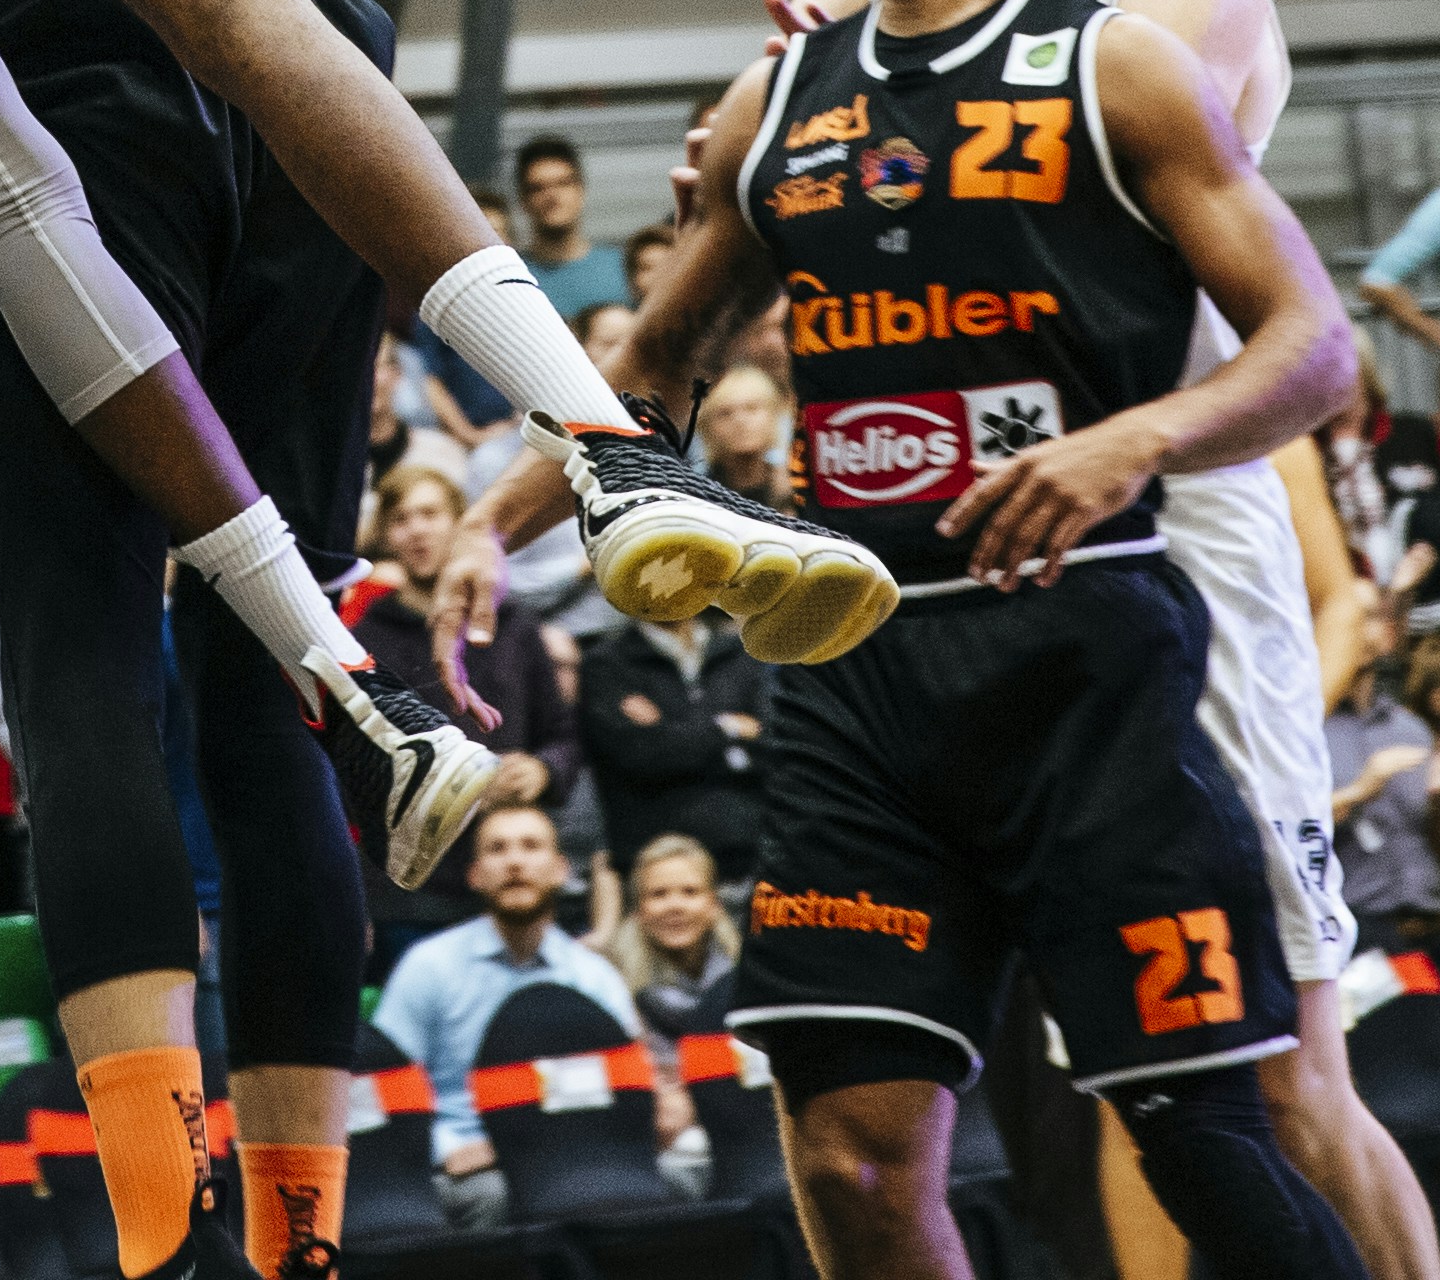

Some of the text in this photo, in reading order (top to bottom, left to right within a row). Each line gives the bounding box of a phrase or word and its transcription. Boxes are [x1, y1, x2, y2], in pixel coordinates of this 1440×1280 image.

[949, 97, 1074, 205] 23
[814, 423, 962, 477] Helios
[1120, 906, 1246, 1037] 23
